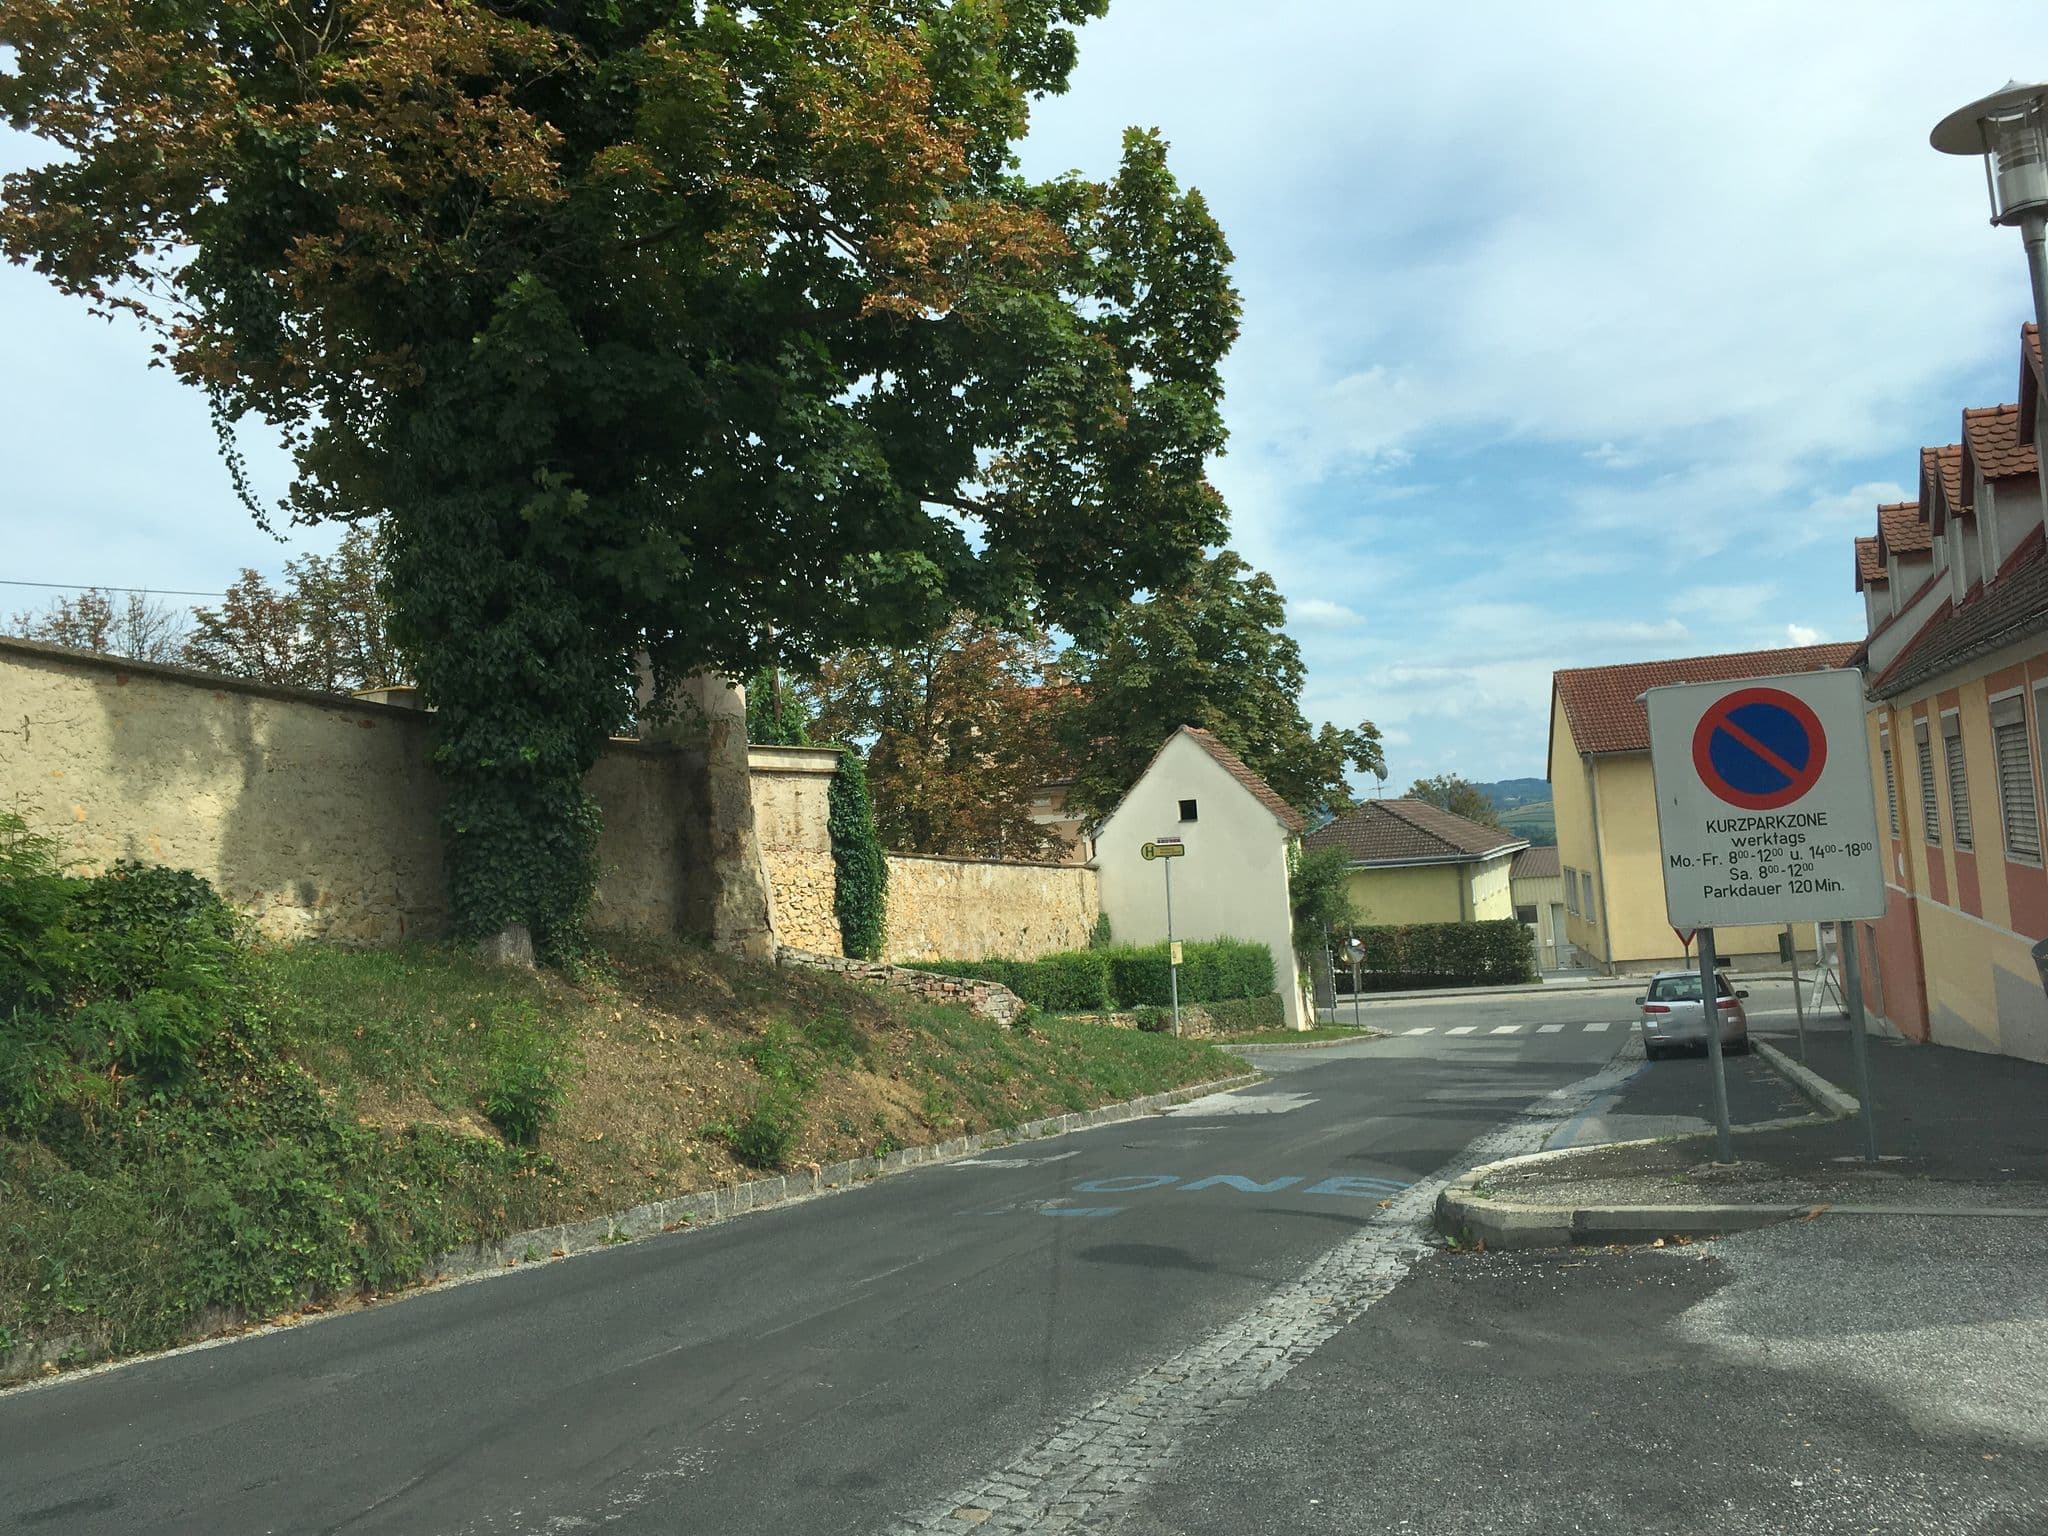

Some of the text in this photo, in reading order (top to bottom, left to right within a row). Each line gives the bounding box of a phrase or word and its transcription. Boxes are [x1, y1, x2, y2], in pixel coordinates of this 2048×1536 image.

[1706, 812, 1828, 833] KURZPARKZONE
[1731, 832, 1806, 847] werktags
[1670, 853, 1723, 868] Mo.-Fr.
[1790, 850, 1803, 860] u.
[1730, 867, 1753, 881] Sa.
[1704, 878, 1845, 898] Parkdauer 120 Min.
